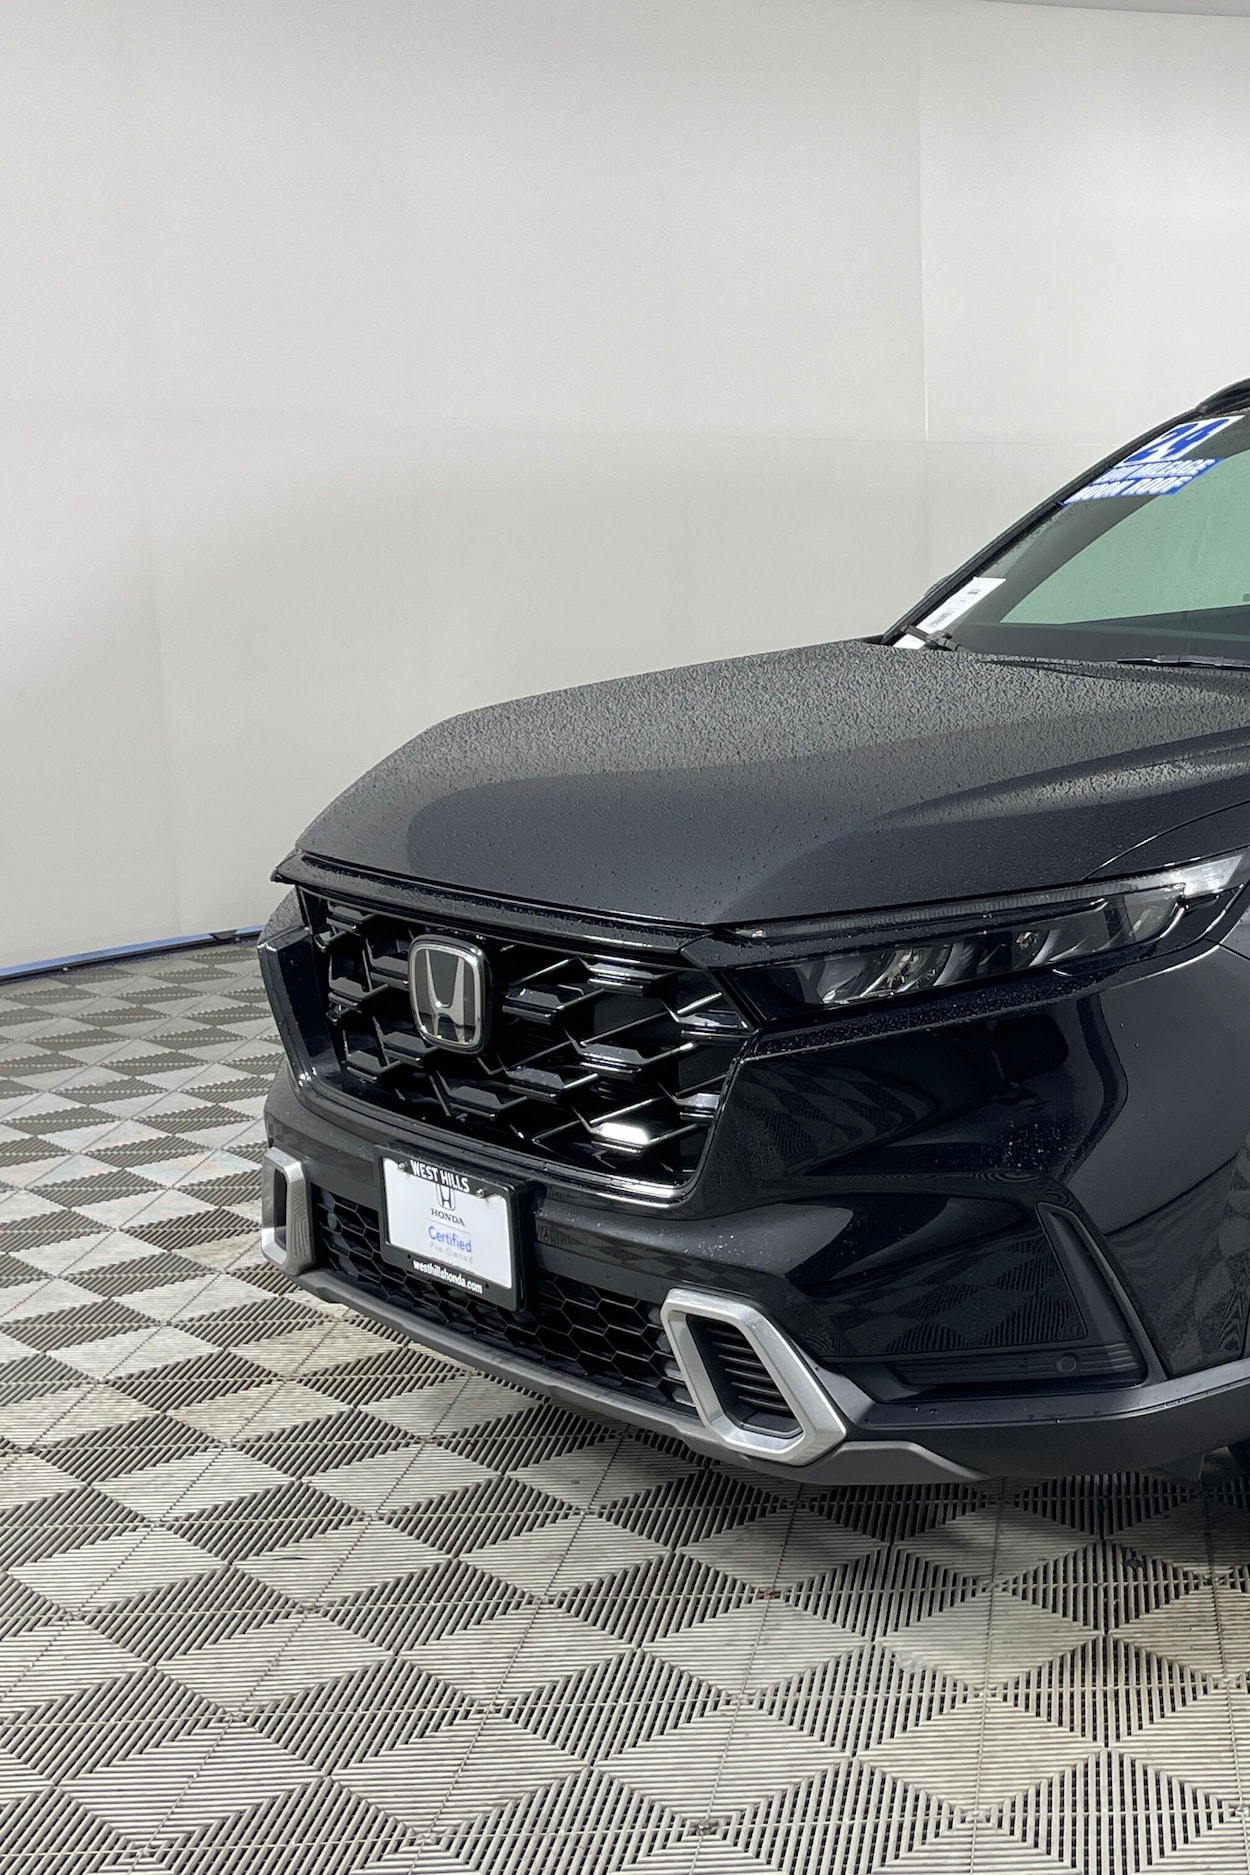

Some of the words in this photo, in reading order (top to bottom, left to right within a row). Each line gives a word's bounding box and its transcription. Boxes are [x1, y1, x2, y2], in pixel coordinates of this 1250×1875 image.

[1122, 418, 1230, 464] 24
[1127, 459, 1215, 479] MILEAGE
[1064, 479, 1136, 504] MOON
[1120, 476, 1193, 496] ROOF
[410, 1160, 439, 1183] WEST
[439, 1170, 470, 1193] HILLS
[430, 1208, 466, 1227] HONDA
[428, 1226, 472, 1253] Certified
[412, 1259, 483, 1295] westhillshonda.com
